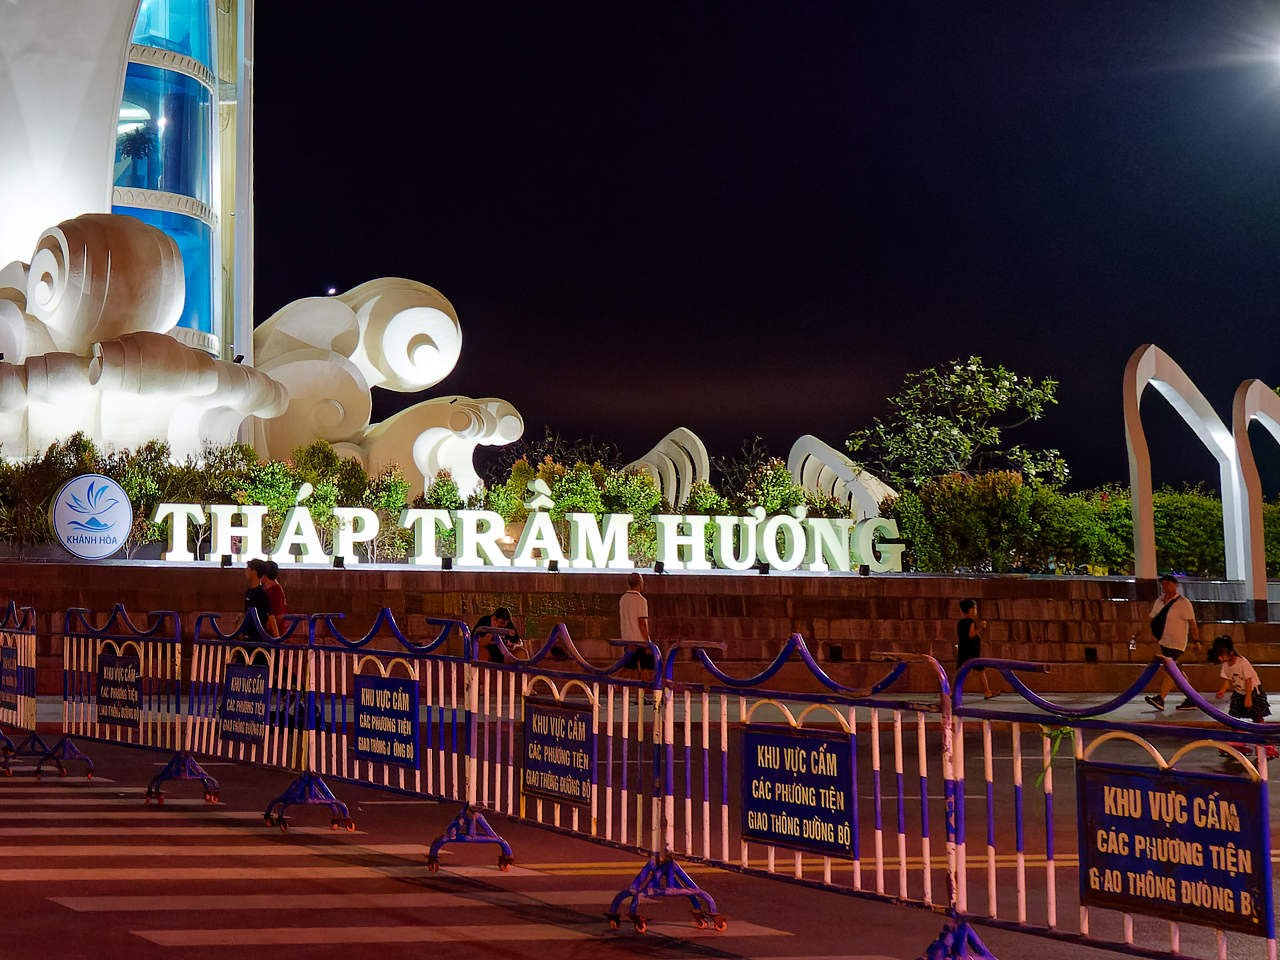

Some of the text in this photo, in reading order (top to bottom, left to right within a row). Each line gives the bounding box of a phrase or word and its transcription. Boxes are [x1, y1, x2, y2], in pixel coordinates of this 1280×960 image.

[66, 534, 118, 545] KHÁNH HÒA
[153, 479, 906, 573] THÁP TRẦM HƯƠNG
[361, 687, 375, 707] KHU
[375, 688, 391, 712] VỰC
[359, 712, 412, 737] CÁC PHƯƠNG TIỆN
[532, 713, 586, 742] KHU VỰC CẤM
[528, 741, 589, 772] CÁC PHƯƠNG TIỆN
[757, 743, 838, 777] KHU VỰC CẤM
[526, 769, 591, 802] GIAO THÔNG ĐƯỜNG BỘ
[752, 776, 845, 813] CÁC PHƯƠNG TIỆN
[1103, 785, 1142, 819] KHU
[1148, 790, 1189, 827] VỰC
[748, 810, 851, 850] GIAO THÔNG ĐƯỜNG BỘ
[1096, 826, 1253, 877] CÁC PHƯƠNG TIỆN
[1089, 867, 1122, 893] GAO
[1127, 870, 1176, 902] THÔNG
[1181, 878, 1235, 913] ĐƯỜNG
